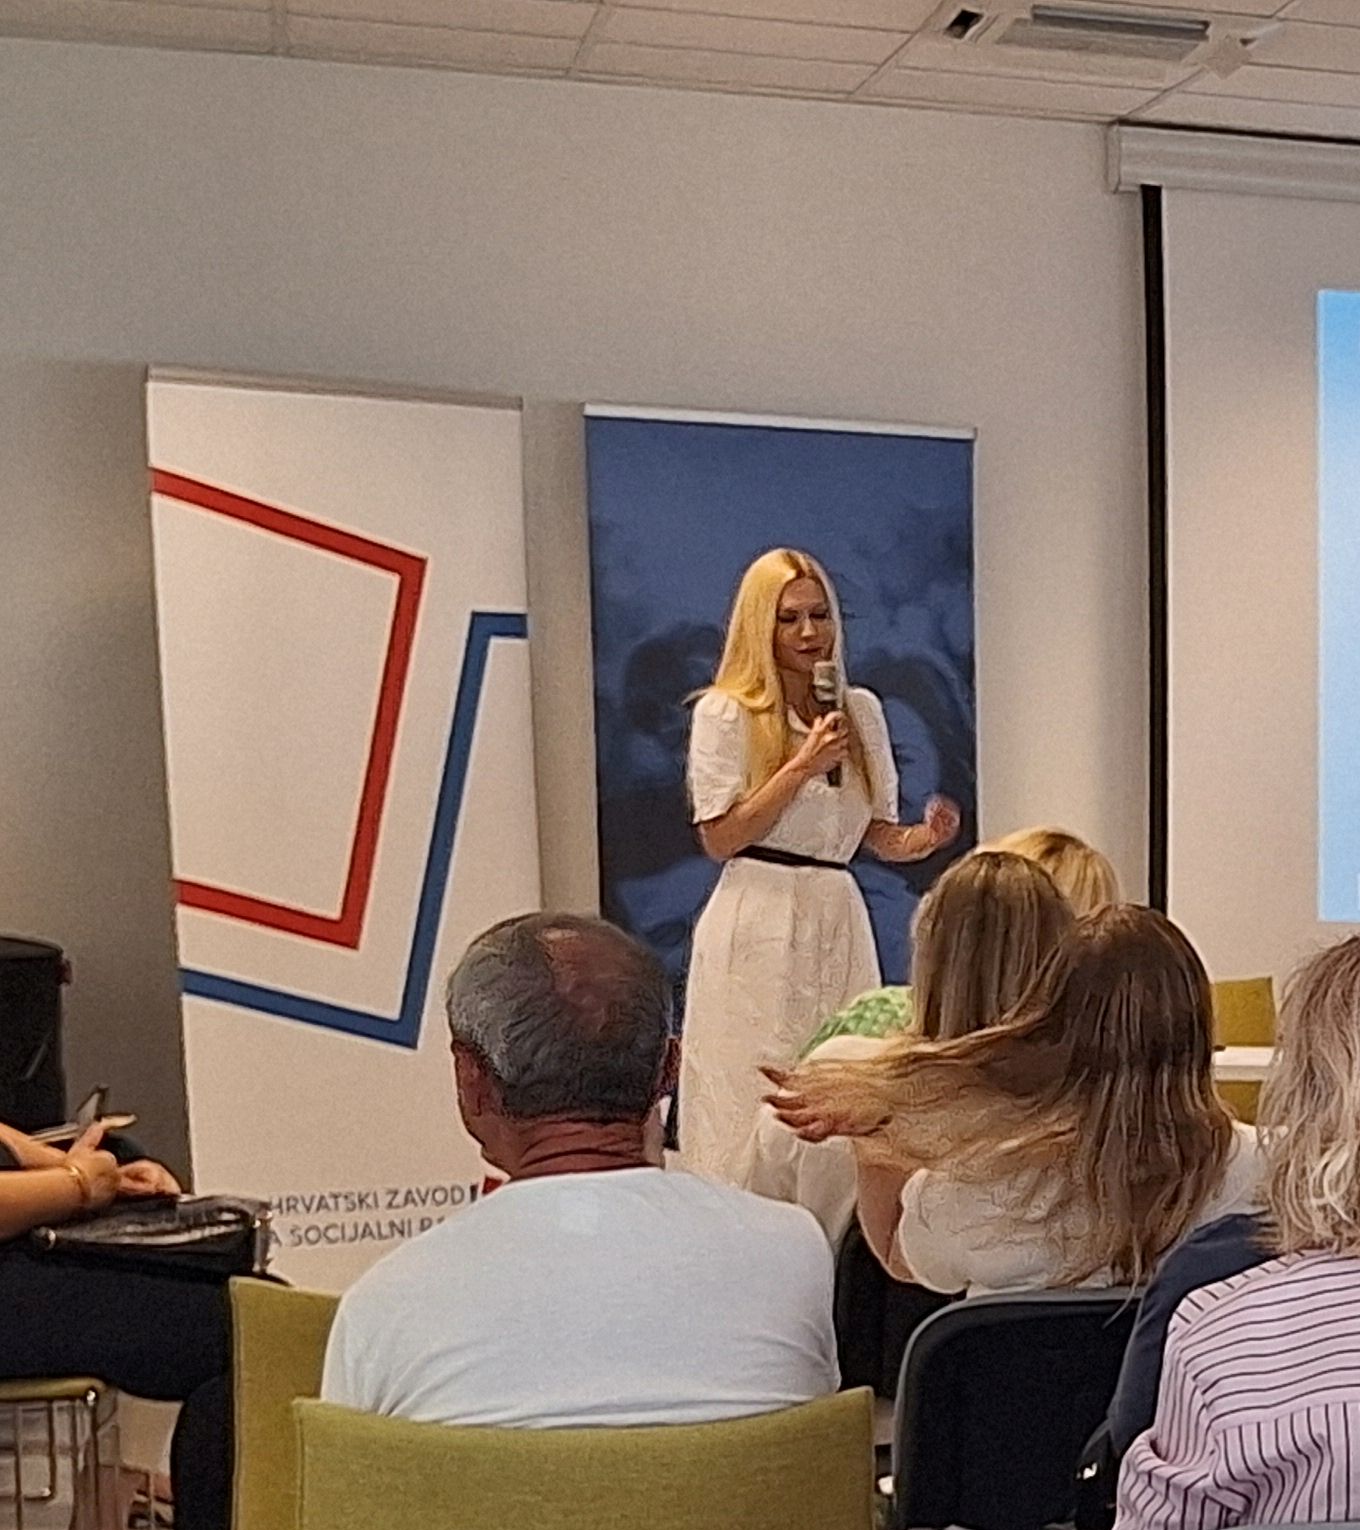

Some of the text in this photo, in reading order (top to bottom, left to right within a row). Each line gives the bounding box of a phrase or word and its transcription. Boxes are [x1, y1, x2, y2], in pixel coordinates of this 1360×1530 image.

[269, 1183, 466, 1215] HRVATSKI ZAVOD
[289, 1218, 413, 1248] SOCIJALNI
